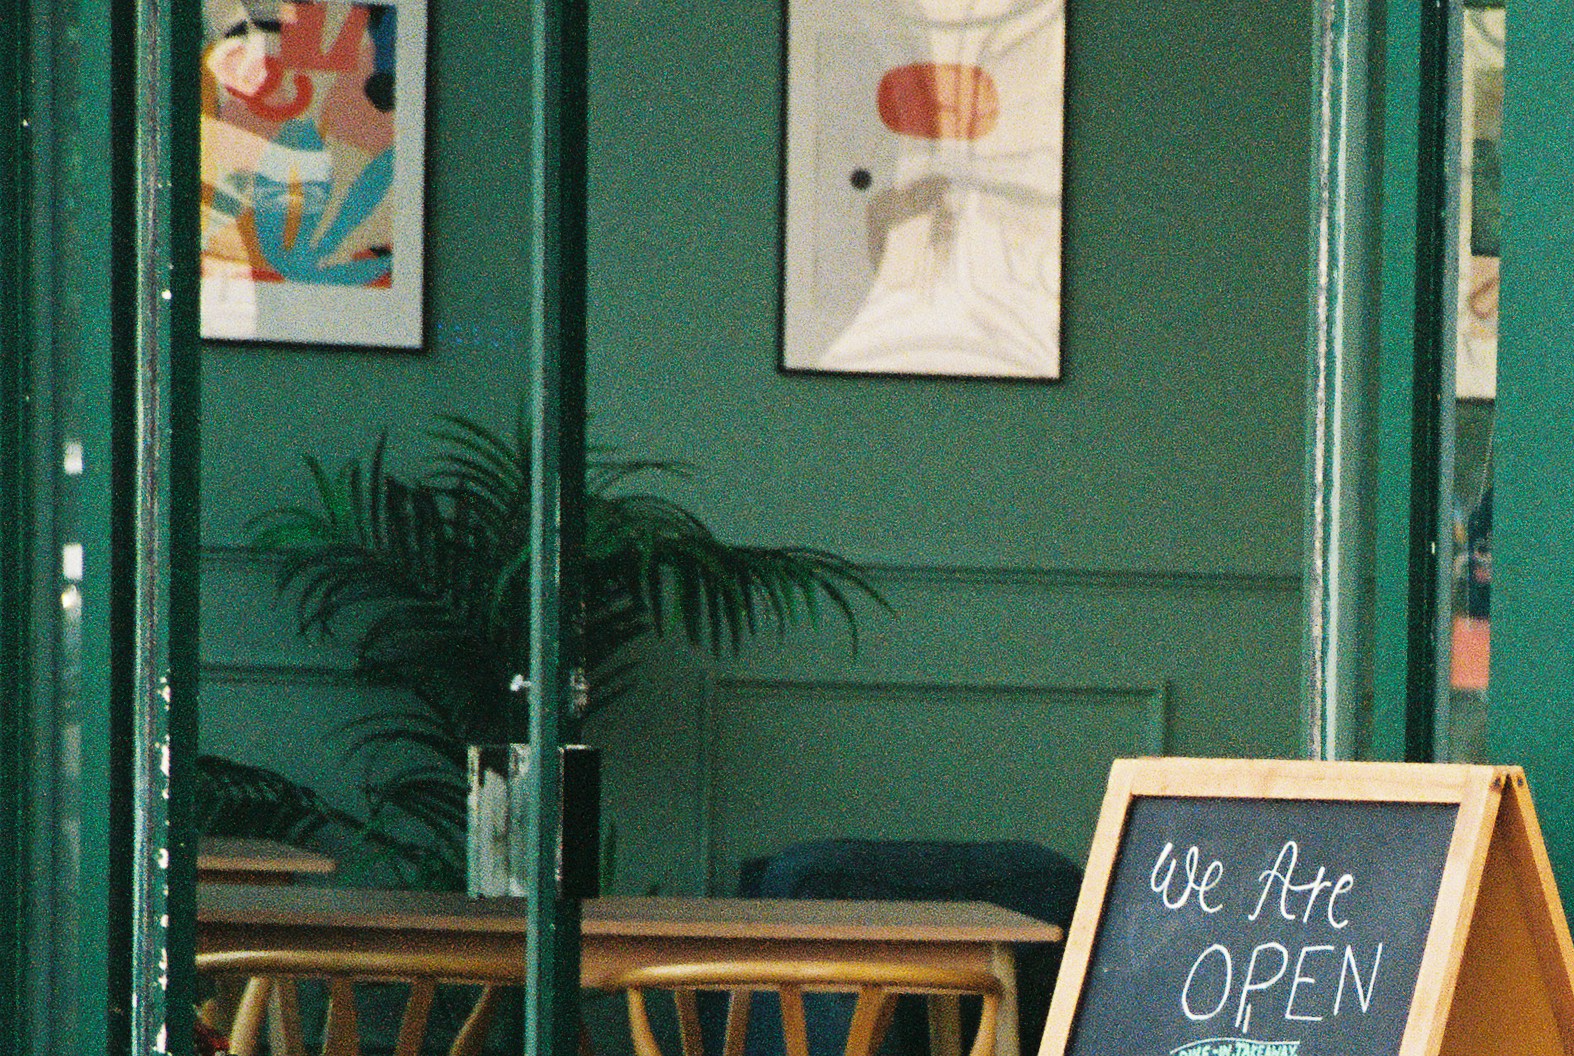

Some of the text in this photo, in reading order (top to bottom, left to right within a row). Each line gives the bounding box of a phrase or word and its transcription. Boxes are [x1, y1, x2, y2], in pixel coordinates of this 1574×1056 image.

[1151, 841, 1354, 928] We Are
[1182, 942, 1383, 1033] OPEN
